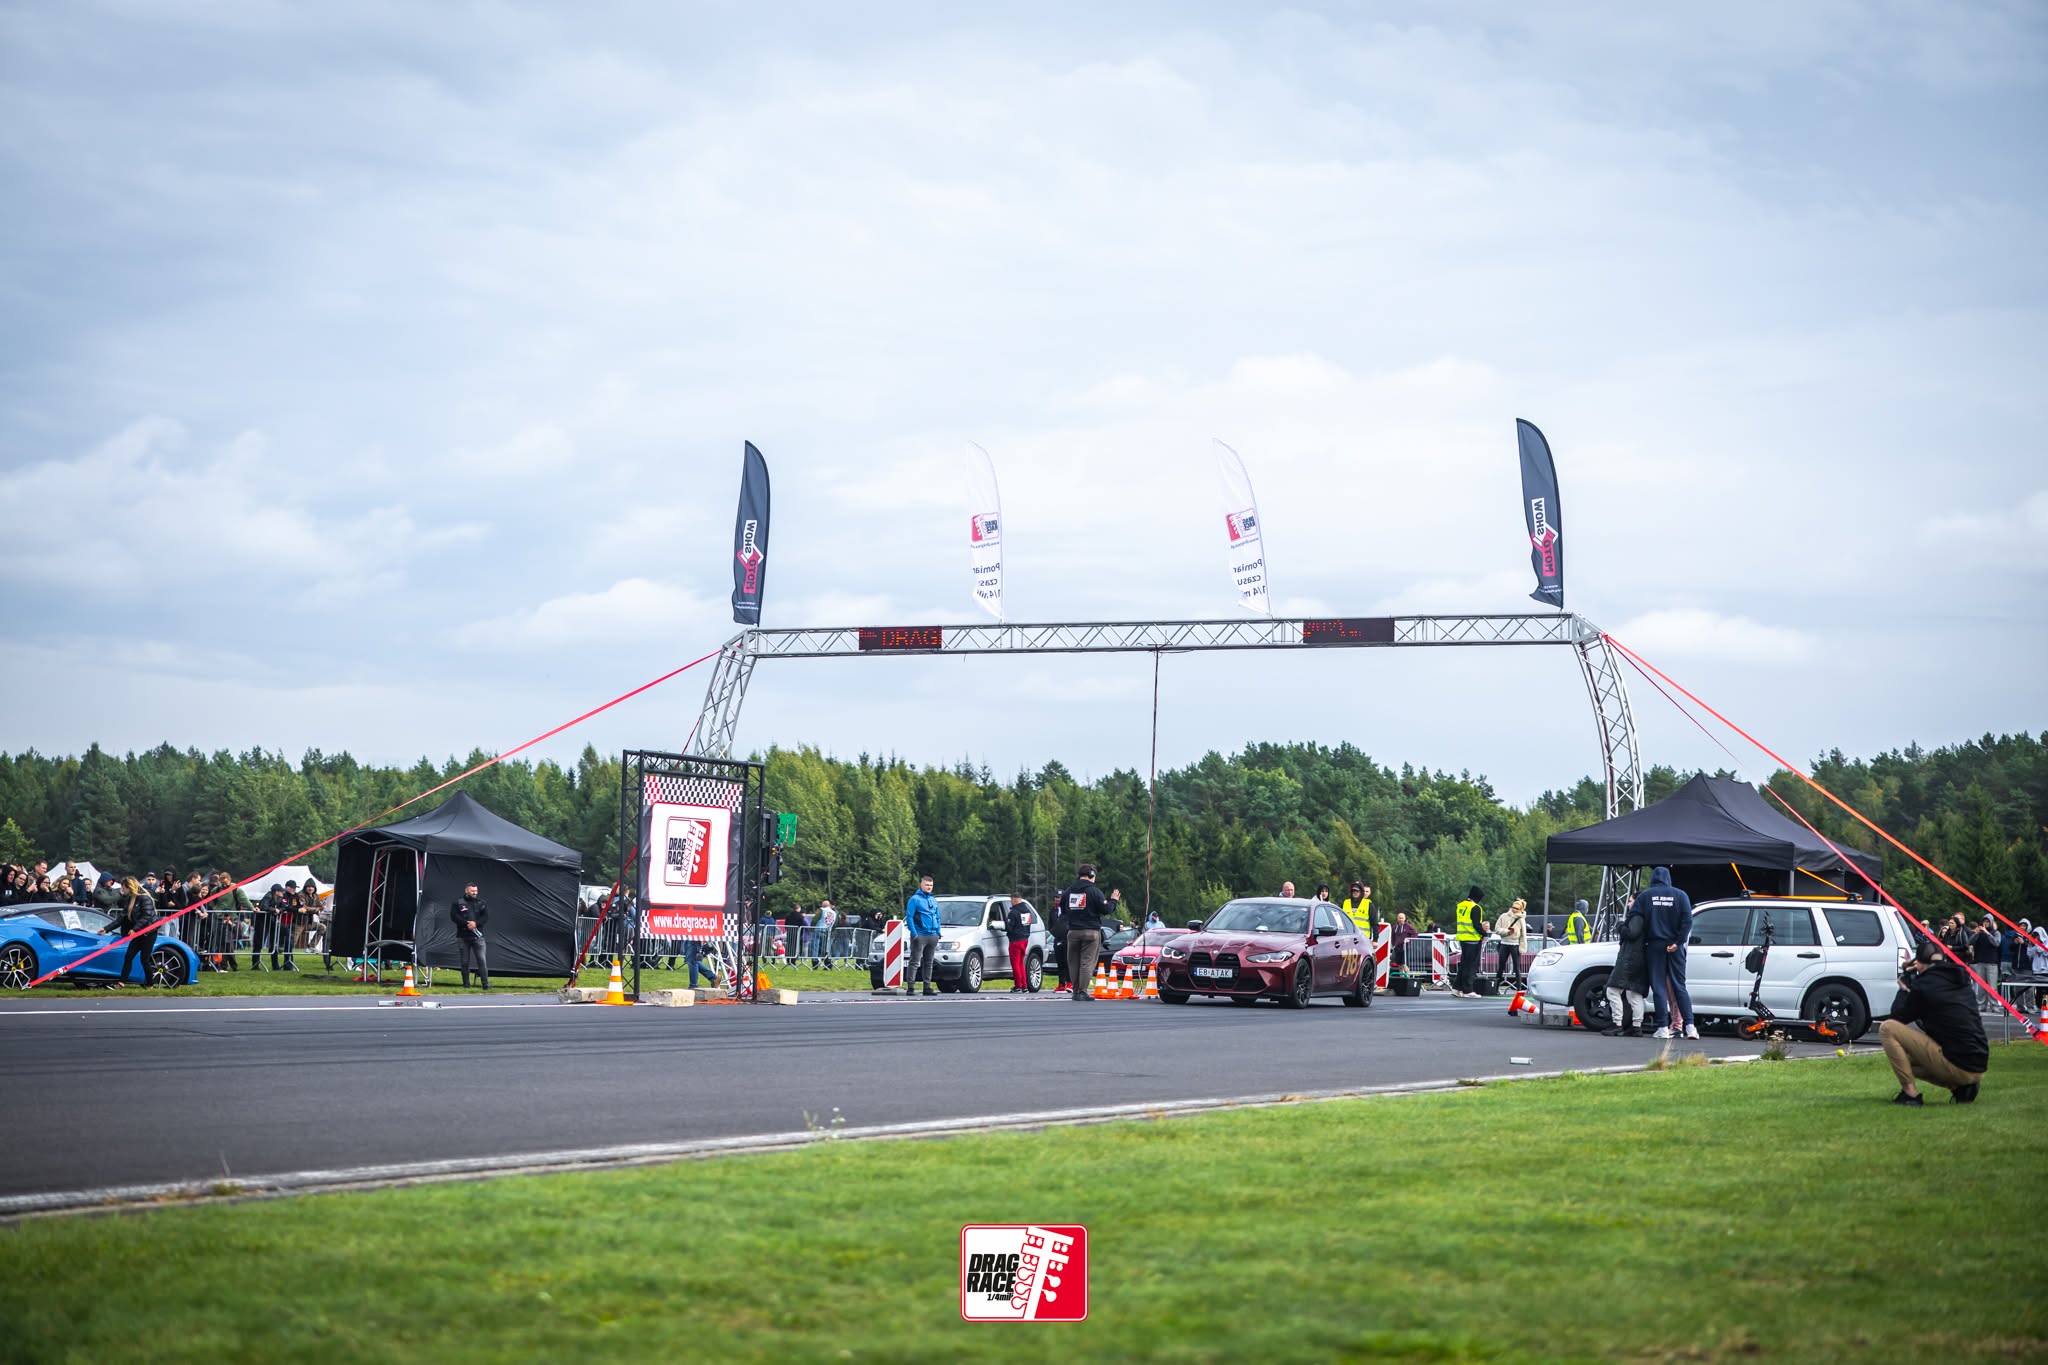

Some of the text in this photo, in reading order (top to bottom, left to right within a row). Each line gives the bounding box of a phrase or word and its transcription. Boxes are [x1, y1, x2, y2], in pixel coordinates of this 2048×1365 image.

[882, 629, 938, 646] DRAG
[669, 838, 686, 850] DRAG
[667, 851, 685, 865] RACE
[653, 913, 718, 933] www.dragrace.pl
[1340, 948, 1358, 976] 718
